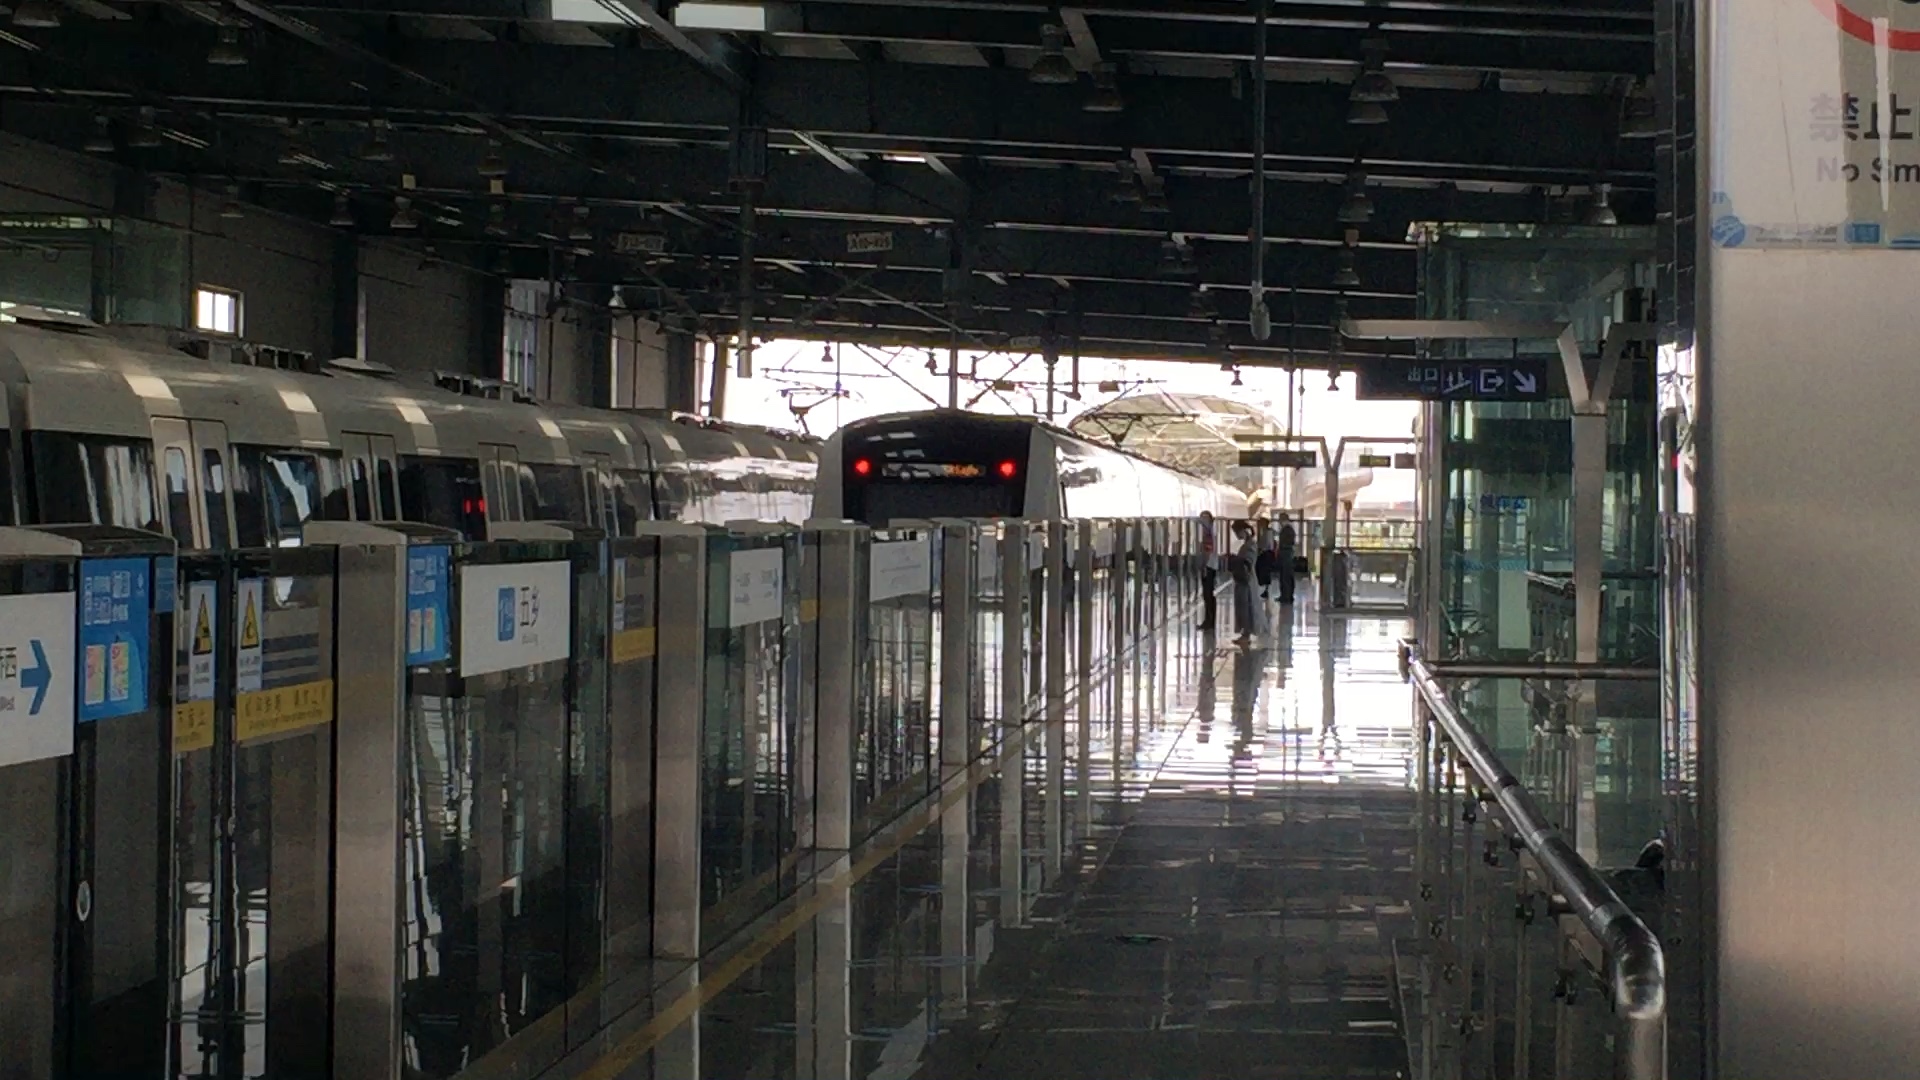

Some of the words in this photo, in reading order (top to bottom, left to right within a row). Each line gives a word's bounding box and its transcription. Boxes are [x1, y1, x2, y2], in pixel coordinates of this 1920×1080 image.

[1809, 92, 1920, 142] 禁止
[1816, 156, 1860, 183] No
[1407, 366, 1438, 382] 出口
